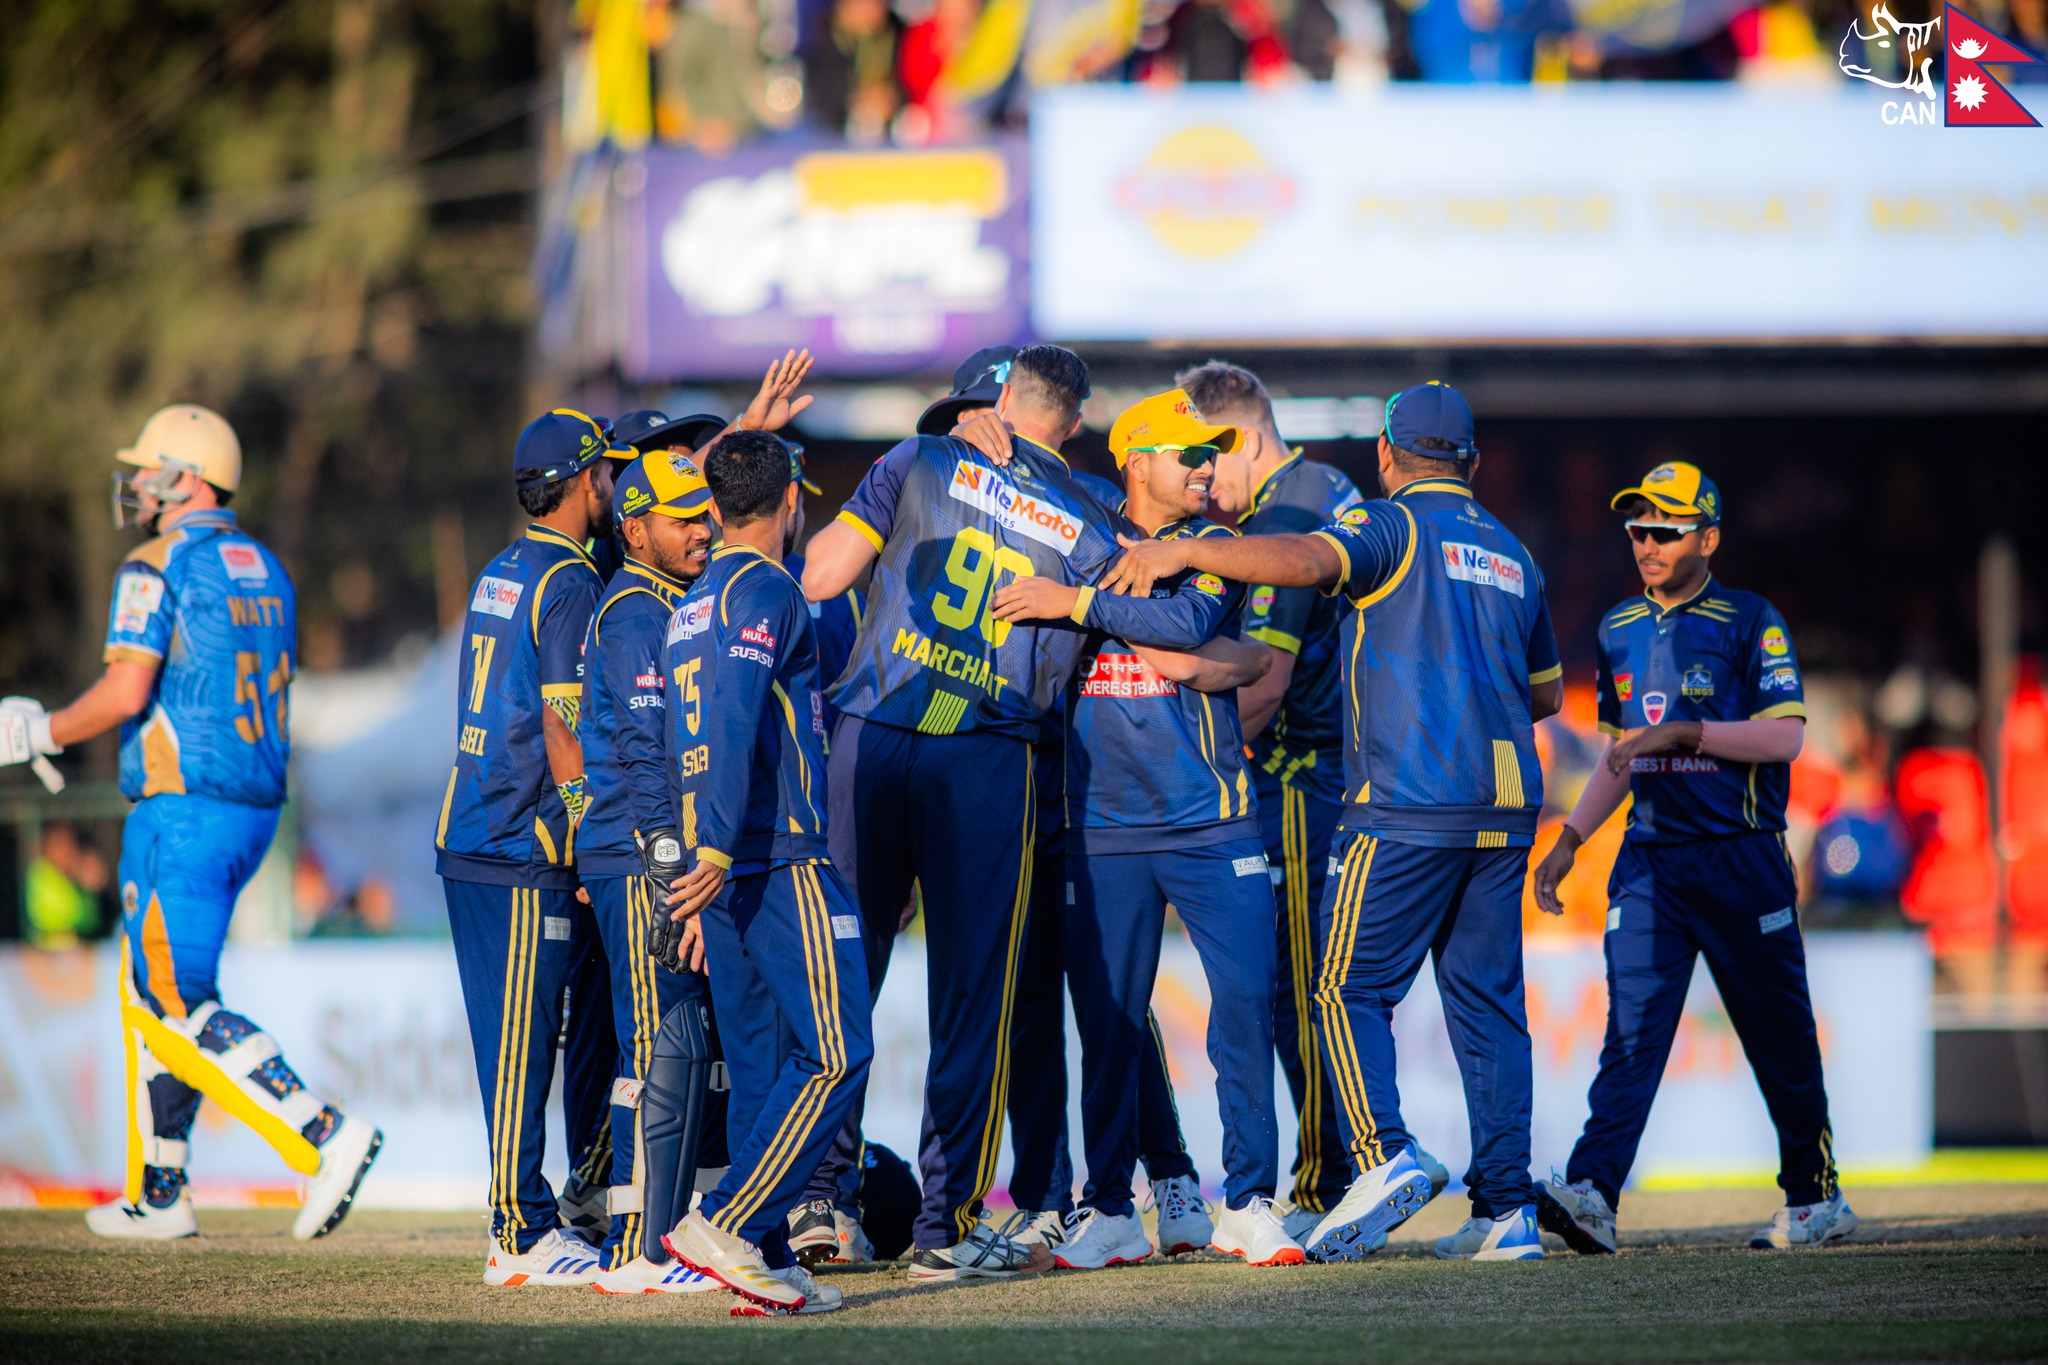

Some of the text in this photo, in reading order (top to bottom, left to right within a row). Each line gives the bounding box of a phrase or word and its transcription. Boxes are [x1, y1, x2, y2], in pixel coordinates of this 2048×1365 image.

[226, 596, 284, 627] WATT
[741, 630, 774, 648] HULAS
[1682, 687, 1715, 696] KINGS
[1671, 757, 1719, 772] BANK
